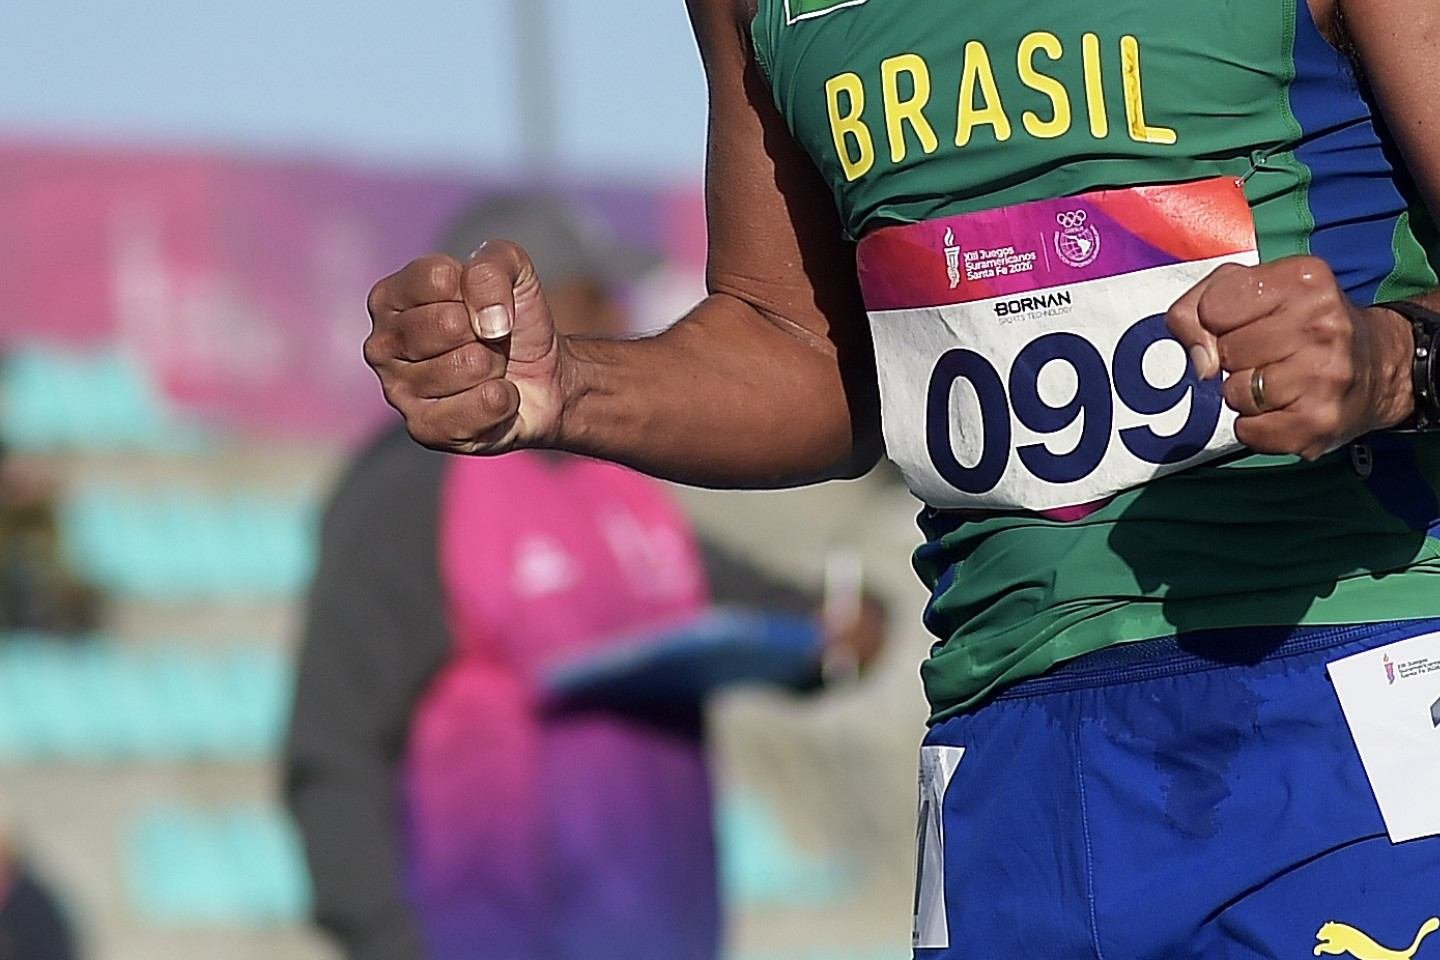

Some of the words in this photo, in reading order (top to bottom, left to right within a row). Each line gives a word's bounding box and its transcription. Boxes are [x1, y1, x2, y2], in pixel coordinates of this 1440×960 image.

[825, 31, 1177, 181] BRASIL
[965, 252, 1036, 271] Suramericanos
[980, 247, 1014, 260] Juegos
[967, 268, 995, 280] Santa
[996, 265, 1008, 276] Fe
[1009, 261, 1033, 274] 2026
[994, 291, 1071, 316] BORNAN
[926, 313, 1223, 494] 099
